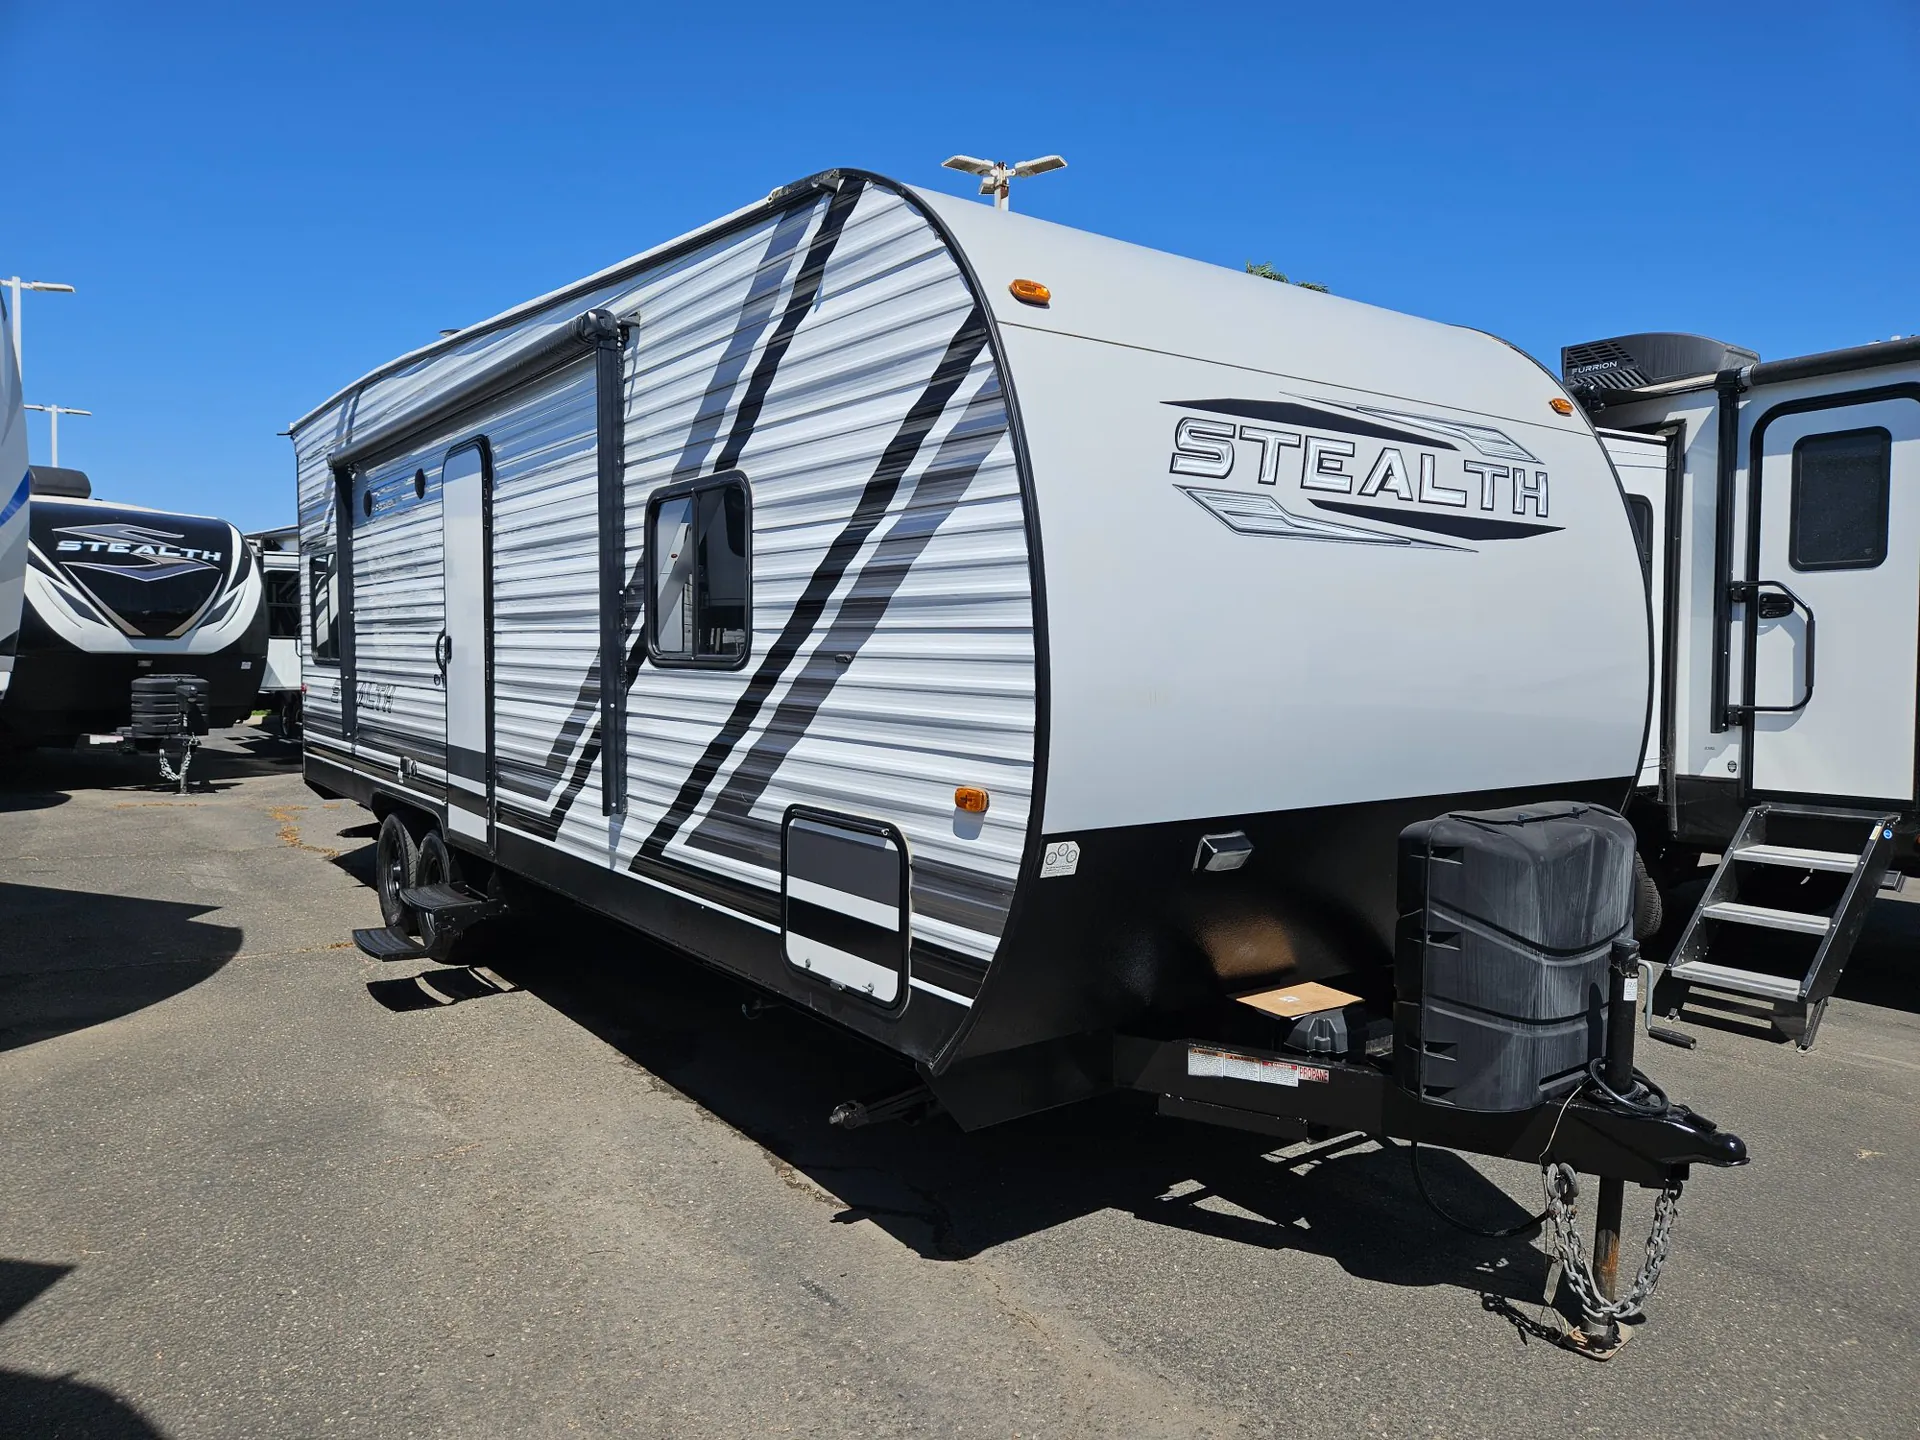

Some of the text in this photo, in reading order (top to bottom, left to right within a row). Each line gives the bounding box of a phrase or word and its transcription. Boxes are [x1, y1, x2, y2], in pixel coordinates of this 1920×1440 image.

[1571, 361, 1618, 375] FURRION
[1169, 416, 1549, 518] STEALTH
[56, 540, 222, 562] STEALTH
[330, 680, 396, 713] SALTH
[1299, 1066, 1328, 1081] PROPANE
